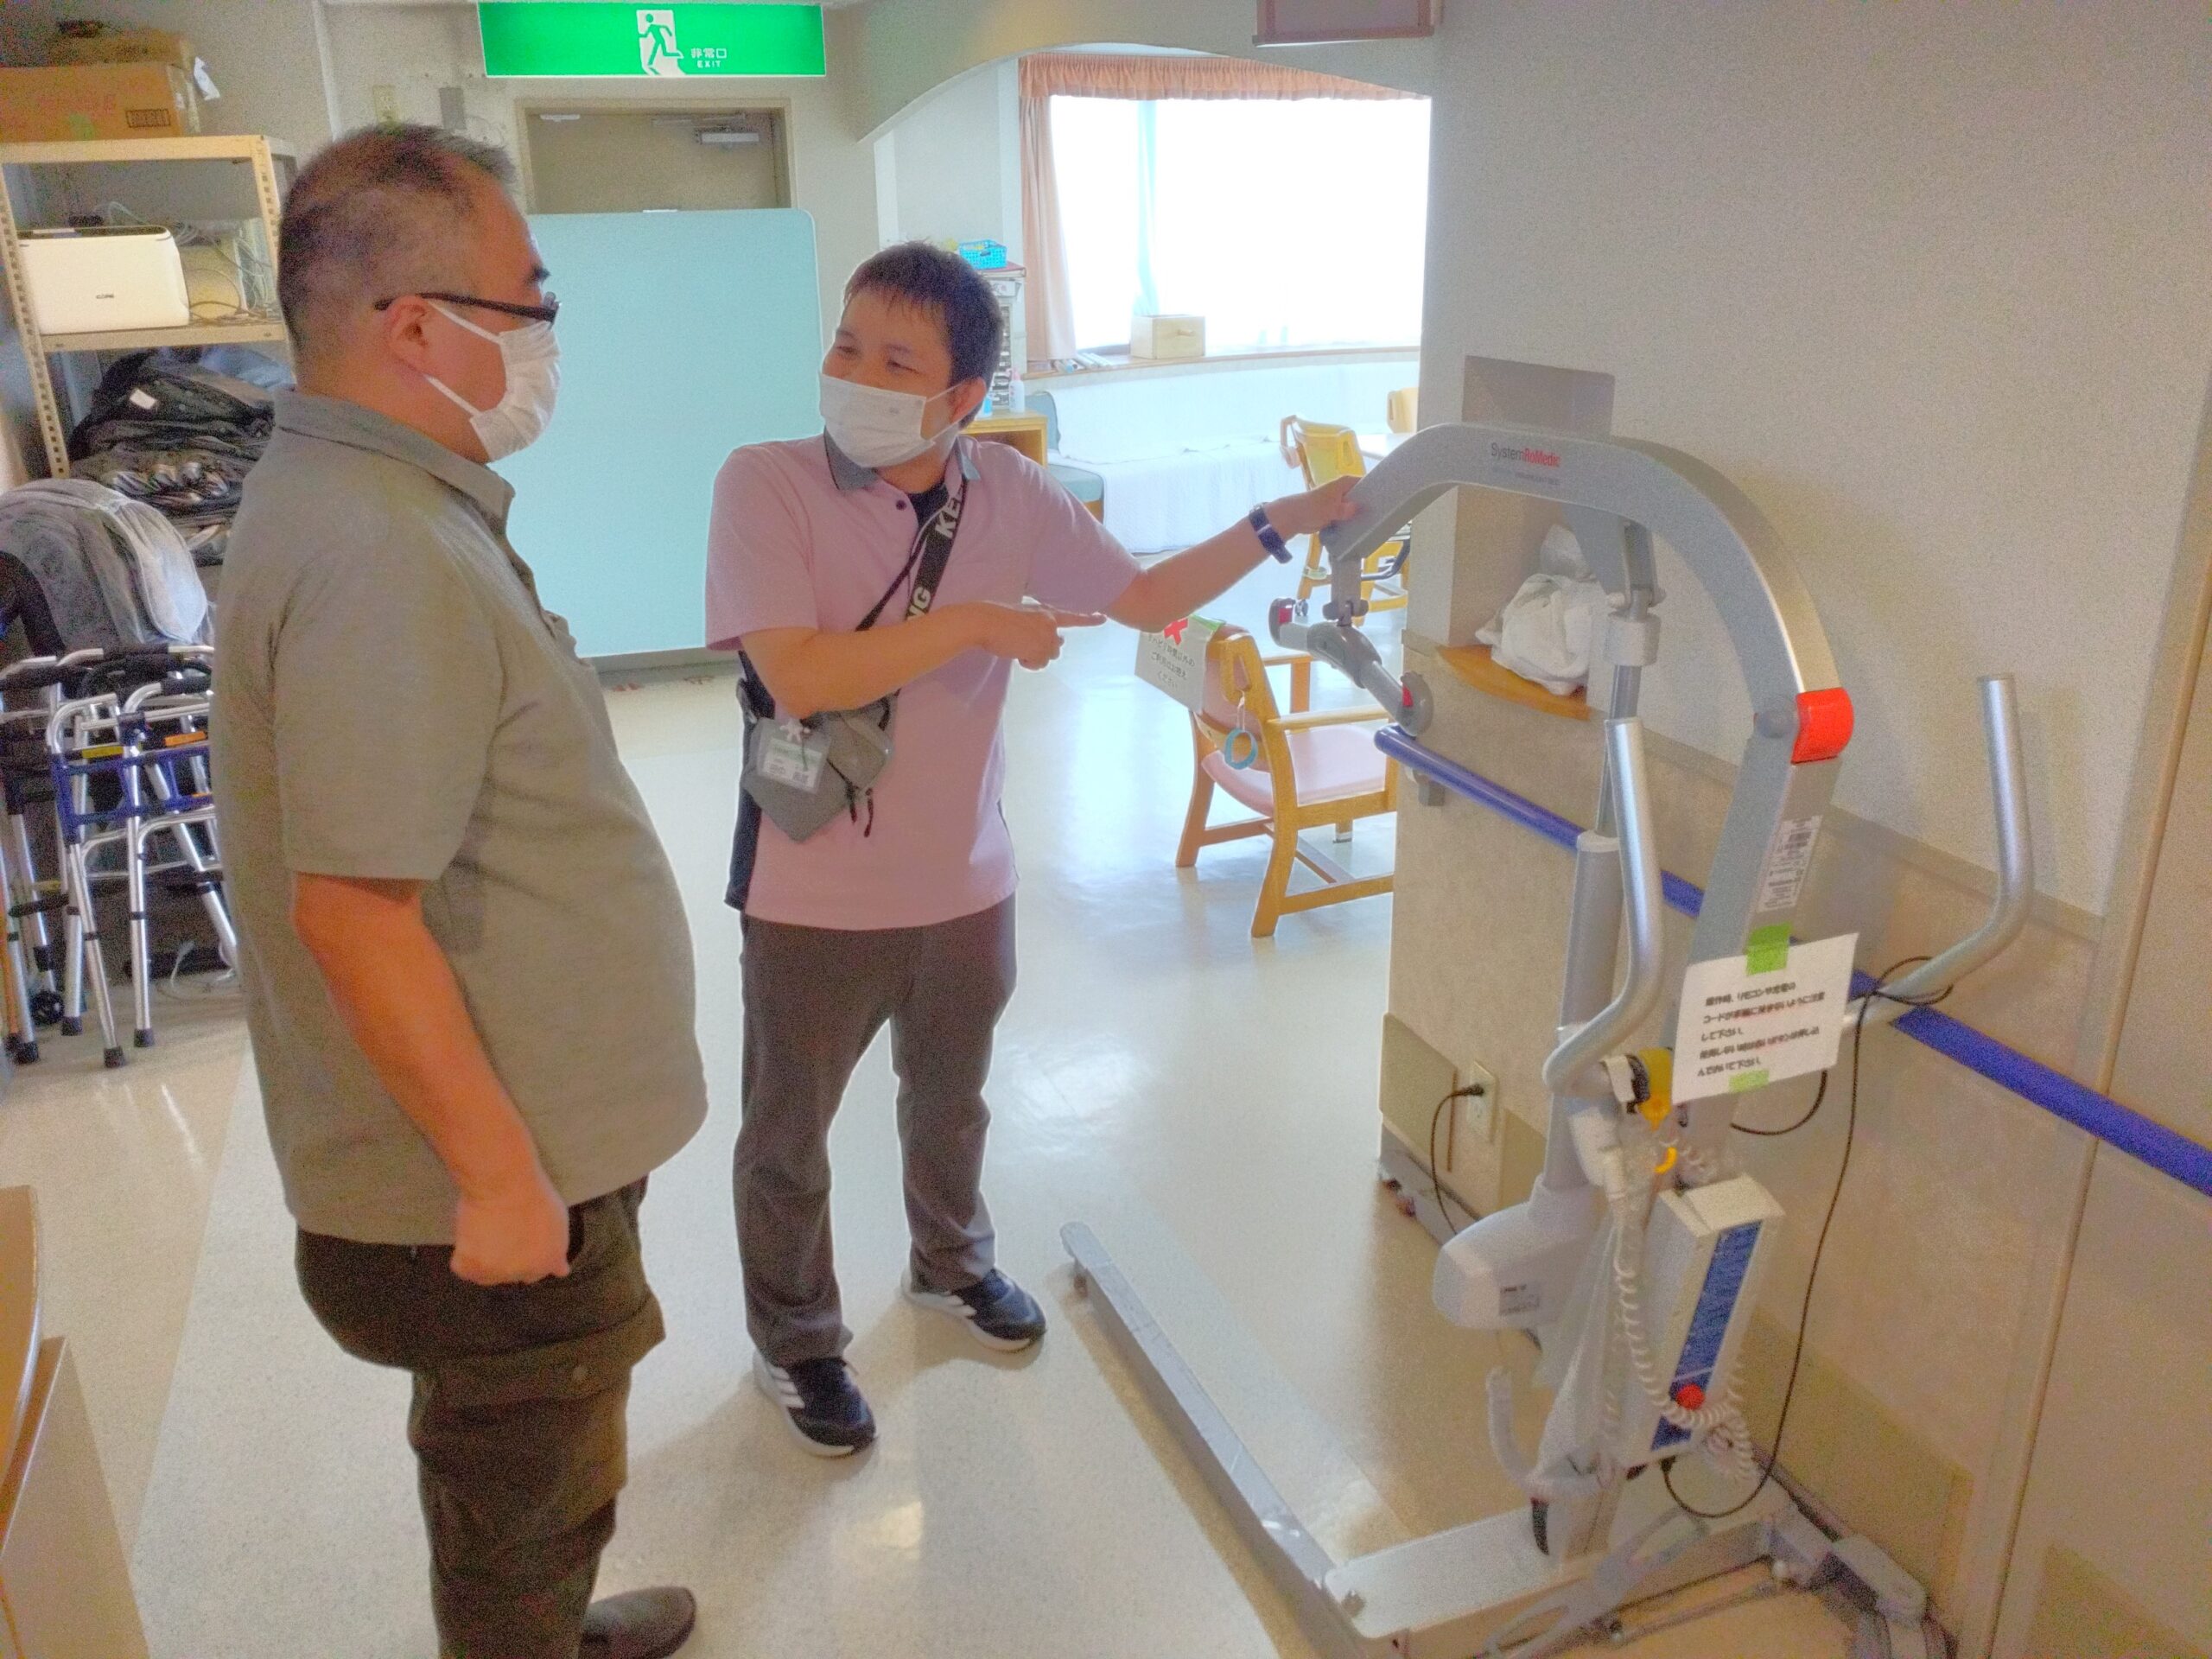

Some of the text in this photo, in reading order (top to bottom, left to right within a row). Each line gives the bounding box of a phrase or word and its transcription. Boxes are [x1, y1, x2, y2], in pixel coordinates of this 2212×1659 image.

[690, 48, 728, 59] 非常口
[696, 60, 721, 68] EXIT
